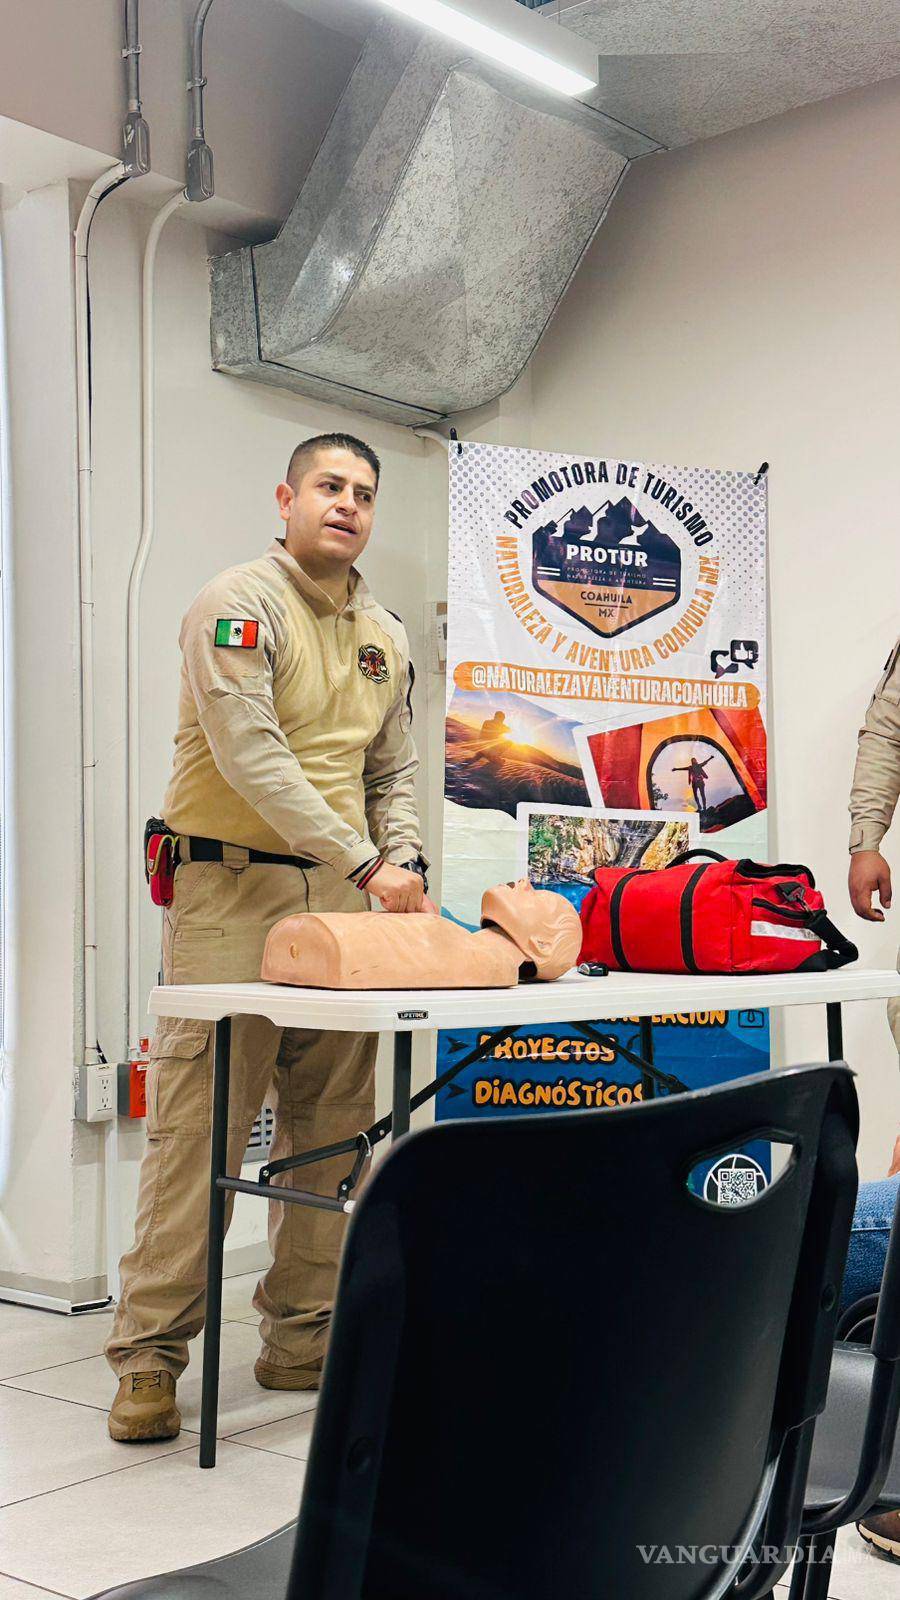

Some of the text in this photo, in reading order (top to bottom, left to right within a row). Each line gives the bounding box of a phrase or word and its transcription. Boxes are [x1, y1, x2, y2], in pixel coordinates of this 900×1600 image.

[503, 461, 714, 547] PROMOTORA DE TURISMO
[566, 543, 648, 568] PROTUR
[495, 535, 720, 672] NATURALEZA Y AVENTURA COAHUILA MX
[580, 591, 633, 605] COAHUILA
[598, 608, 614, 618] MX
[471, 664, 748, 707] @NATURALEZAYAVENTURACOAHUILA
